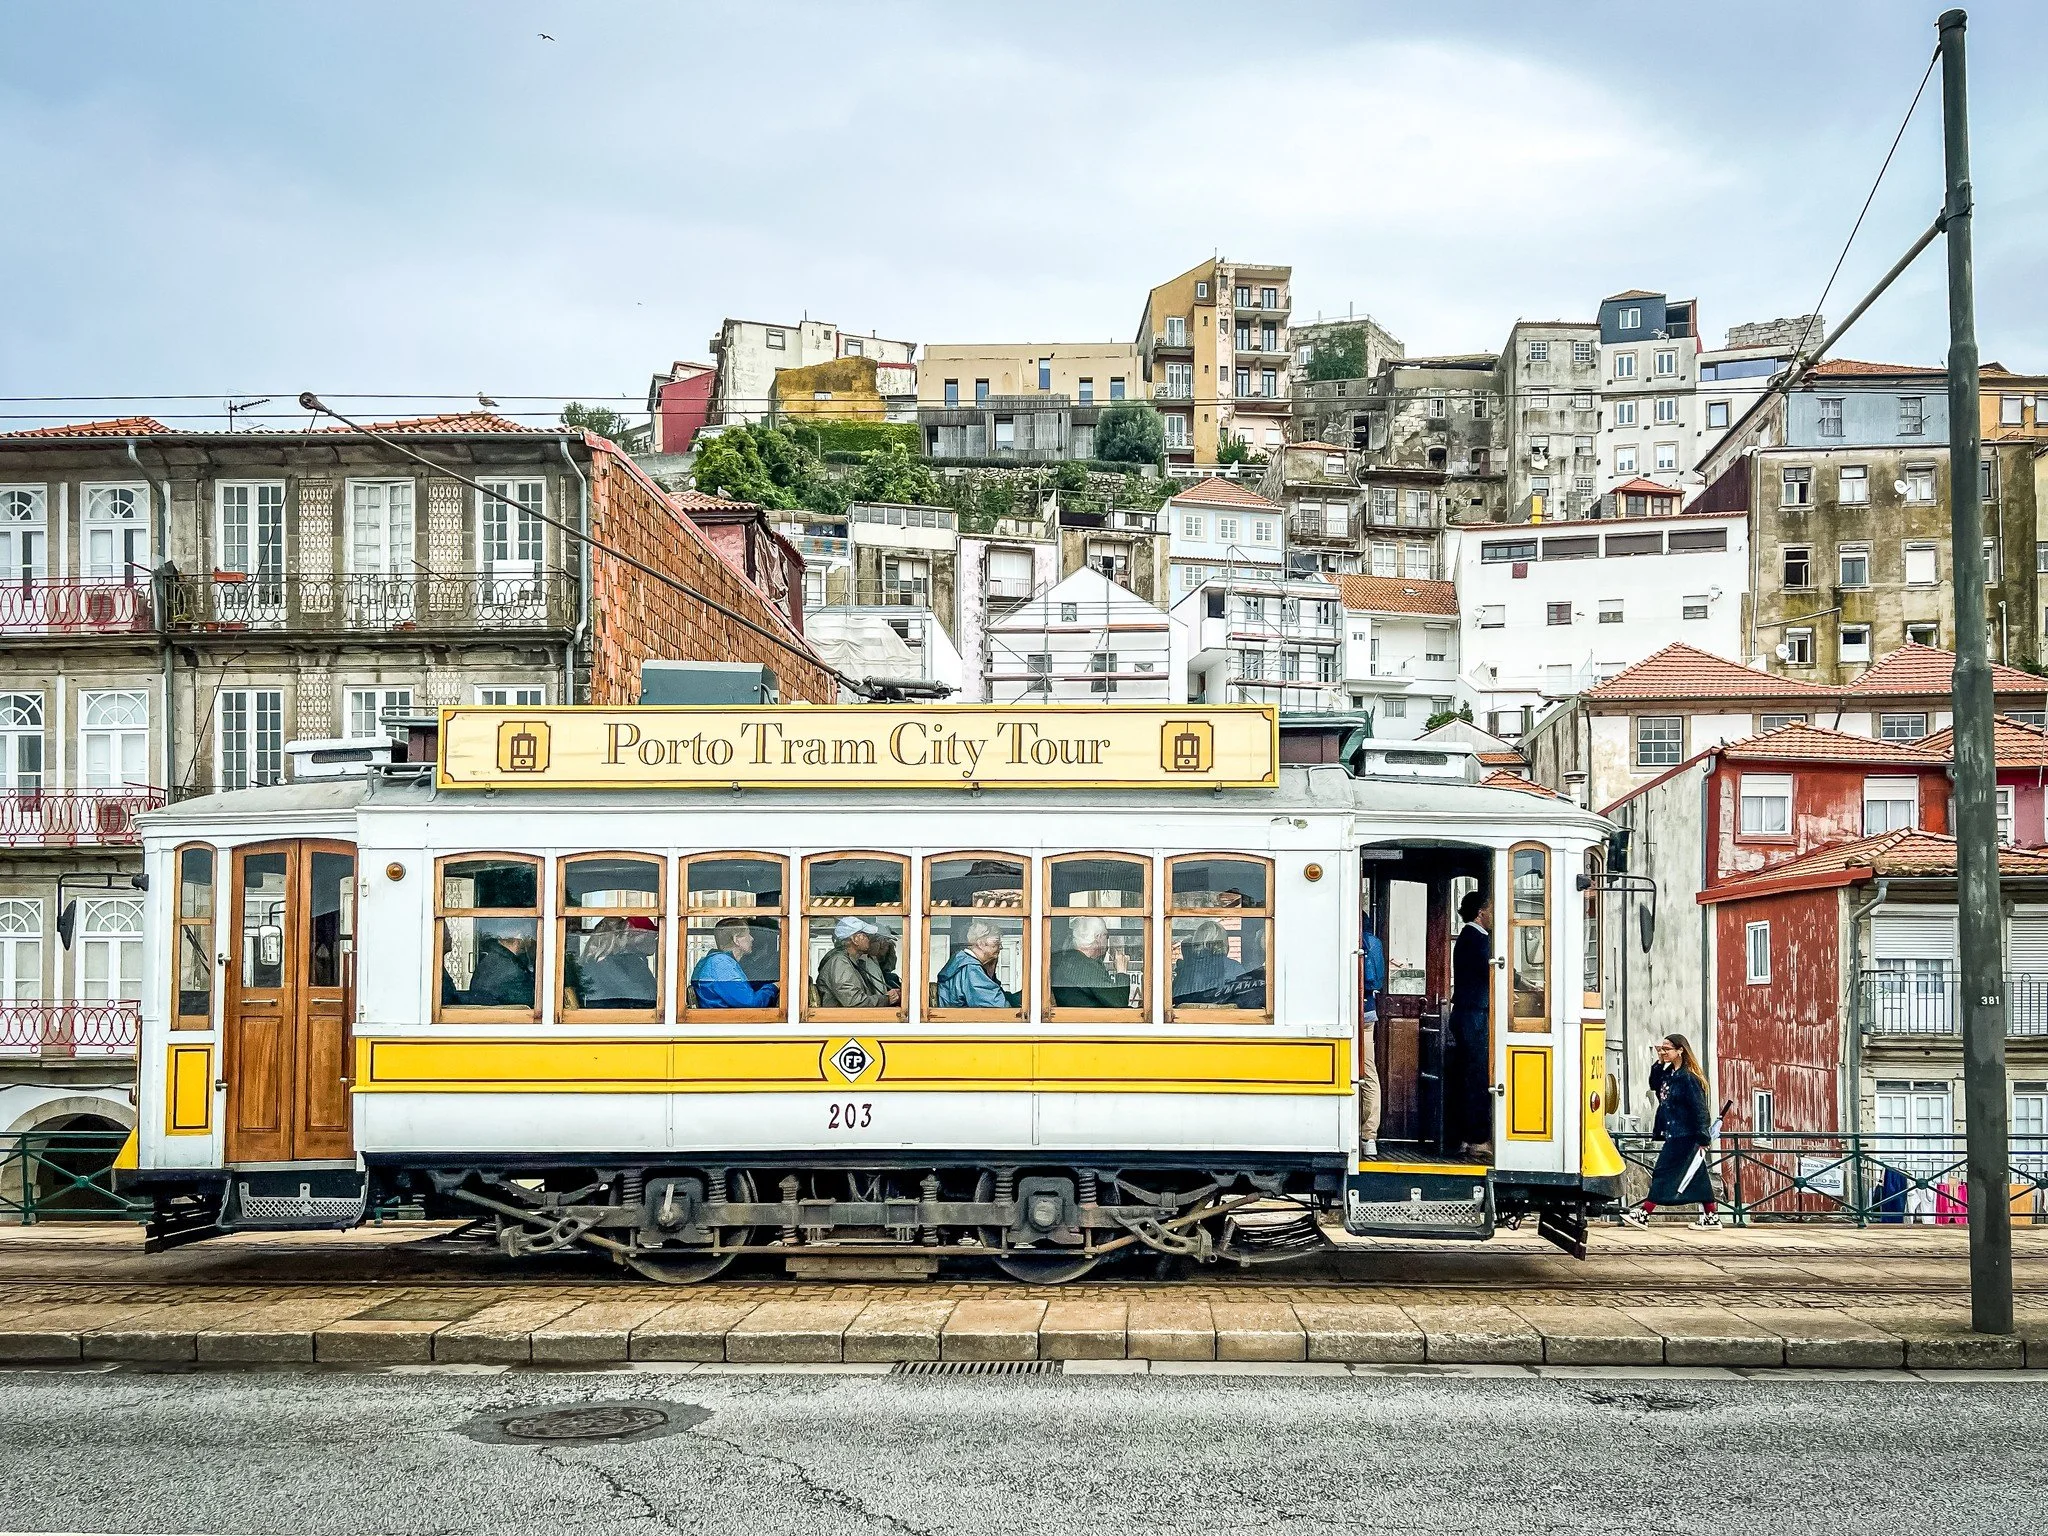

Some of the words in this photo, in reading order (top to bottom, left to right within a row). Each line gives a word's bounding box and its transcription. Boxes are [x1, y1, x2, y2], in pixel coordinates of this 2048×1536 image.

[601, 722, 734, 766] Porto
[741, 722, 878, 766] Tram
[889, 721, 989, 778] City
[996, 722, 1111, 766] Tour
[1981, 995, 2000, 1005] 381
[828, 1103, 872, 1129] 203
